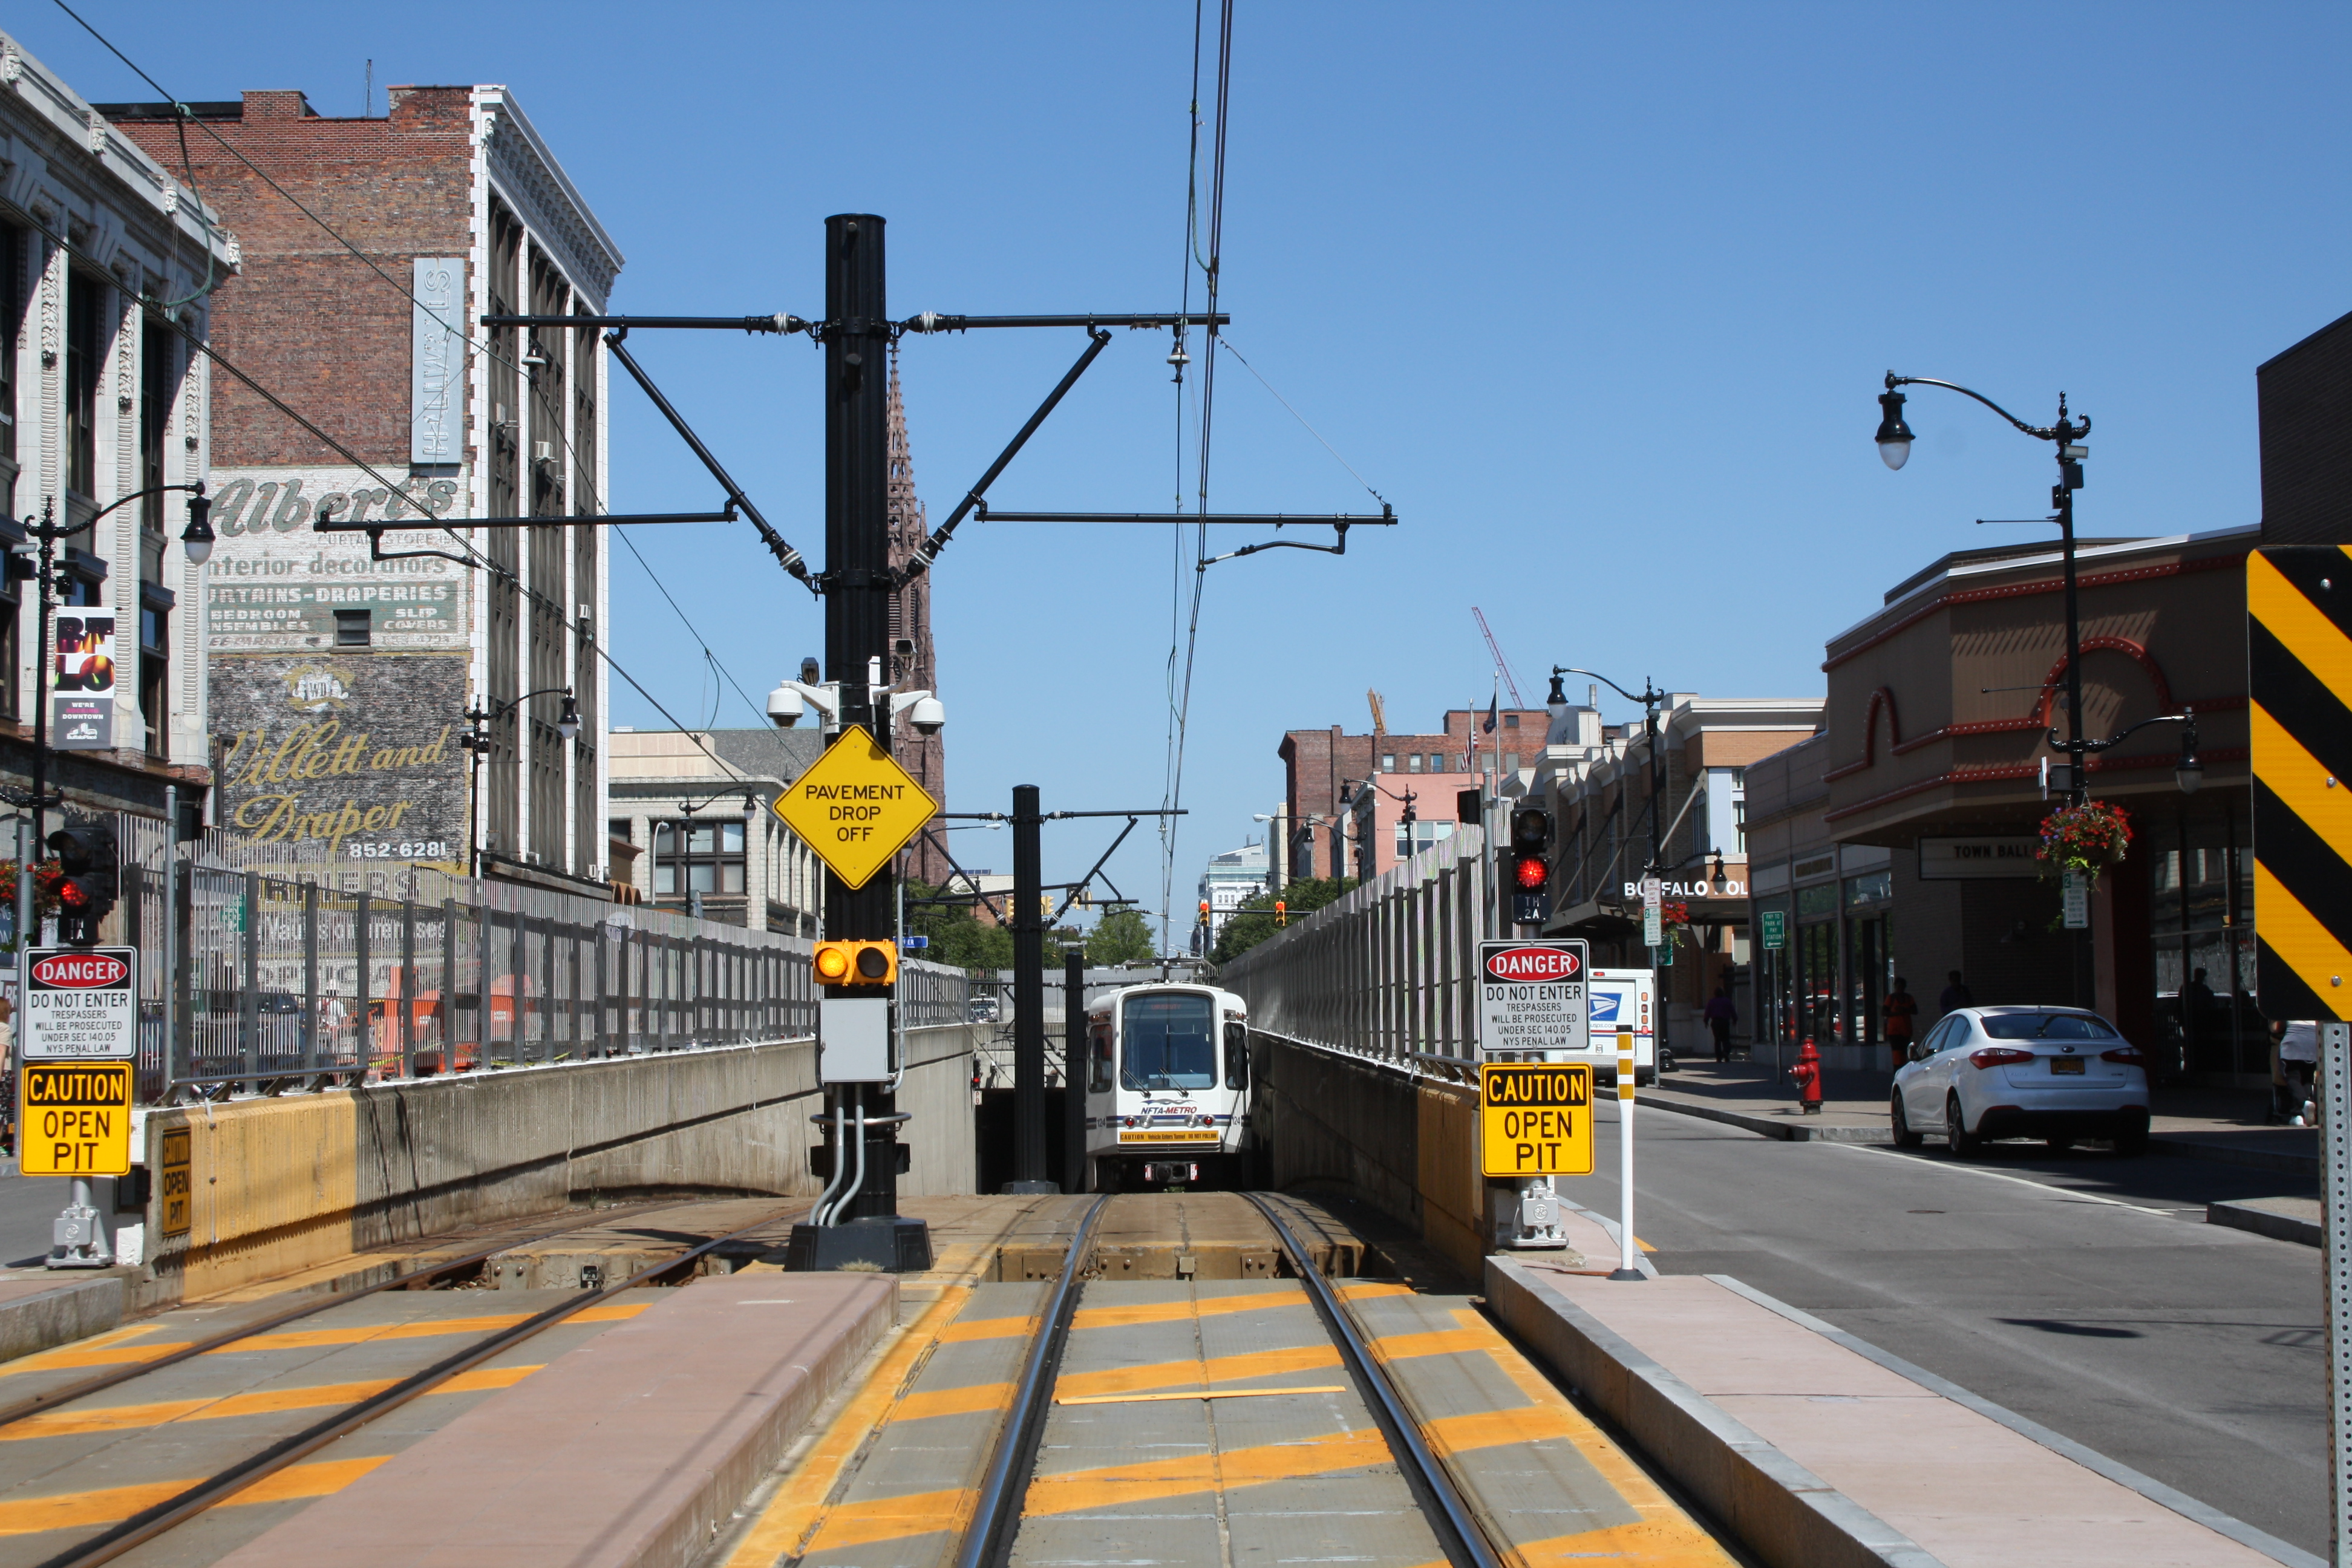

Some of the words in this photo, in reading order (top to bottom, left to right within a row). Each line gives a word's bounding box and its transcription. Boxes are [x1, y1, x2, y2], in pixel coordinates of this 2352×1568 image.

[208, 551, 299, 576] nterior
[211, 609, 301, 620] BEDROOM
[395, 608, 437, 618] SLIP
[208, 621, 310, 632] NSEMBLES
[384, 619, 448, 630] COVERS
[371, 725, 451, 771] and
[806, 785, 905, 800] PAVEMENT
[829, 806, 881, 821] DROP
[235, 789, 414, 854] Draper
[837, 826, 874, 842] OFF
[349, 841, 446, 858] 852-6281
[1954, 846, 1991, 858] TOWN
[1624, 881, 1708, 896] BUFALO
[1524, 897, 1540, 907] TH
[1524, 908, 1540, 919] 2A
[70, 918, 84, 929] TH
[42, 962, 120, 980] DANGER
[1496, 955, 1572, 974] DANGER
[31, 994, 50, 1008] DO
[54, 993, 81, 1008] NOT
[85, 993, 128, 1007] ENTER
[1486, 987, 1504, 1001] DO
[1509, 986, 1535, 1000] NOT
[1540, 985, 1582, 999] ENTER
[51, 1010, 107, 1019] TRESPASSERS
[1506, 1002, 1561, 1012] TRESPASSERS
[36, 1022, 54, 1031] WILL
[56, 1022, 67, 1030] BE
[69, 1021, 122, 1030] PROSECUTED
[1491, 1014, 1510, 1024] WILL
[1512, 1014, 1523, 1023] BE
[1524, 1013, 1577, 1023] PROSECUTED
[42, 1033, 70, 1042] UNDER
[71, 1033, 87, 1042] SEC
[89, 1032, 116, 1041] 140.05
[1498, 1026, 1525, 1035] UNDER
[1527, 1025, 1543, 1034] SEC
[1544, 1025, 1572, 1034] 140.05
[47, 1044, 64, 1053] NYS
[65, 1044, 92, 1053] PENAL
[94, 1044, 111, 1053] LAW
[1503, 1037, 1520, 1046] NYS
[1522, 1037, 1548, 1045] PENAL
[1550, 1036, 1567, 1045] LAW
[30, 1074, 123, 1101] CAUTION
[1489, 1074, 1584, 1102] CAUTION
[44, 1111, 110, 1138] OPEN
[1232, 1117, 1241, 1125] 124
[1504, 1111, 1572, 1138] OPEN
[54, 1142, 99, 1169] PIT
[1517, 1143, 1561, 1170] PIT
[165, 1170, 189, 1197] OPEN
[170, 1200, 183, 1226] PIT
